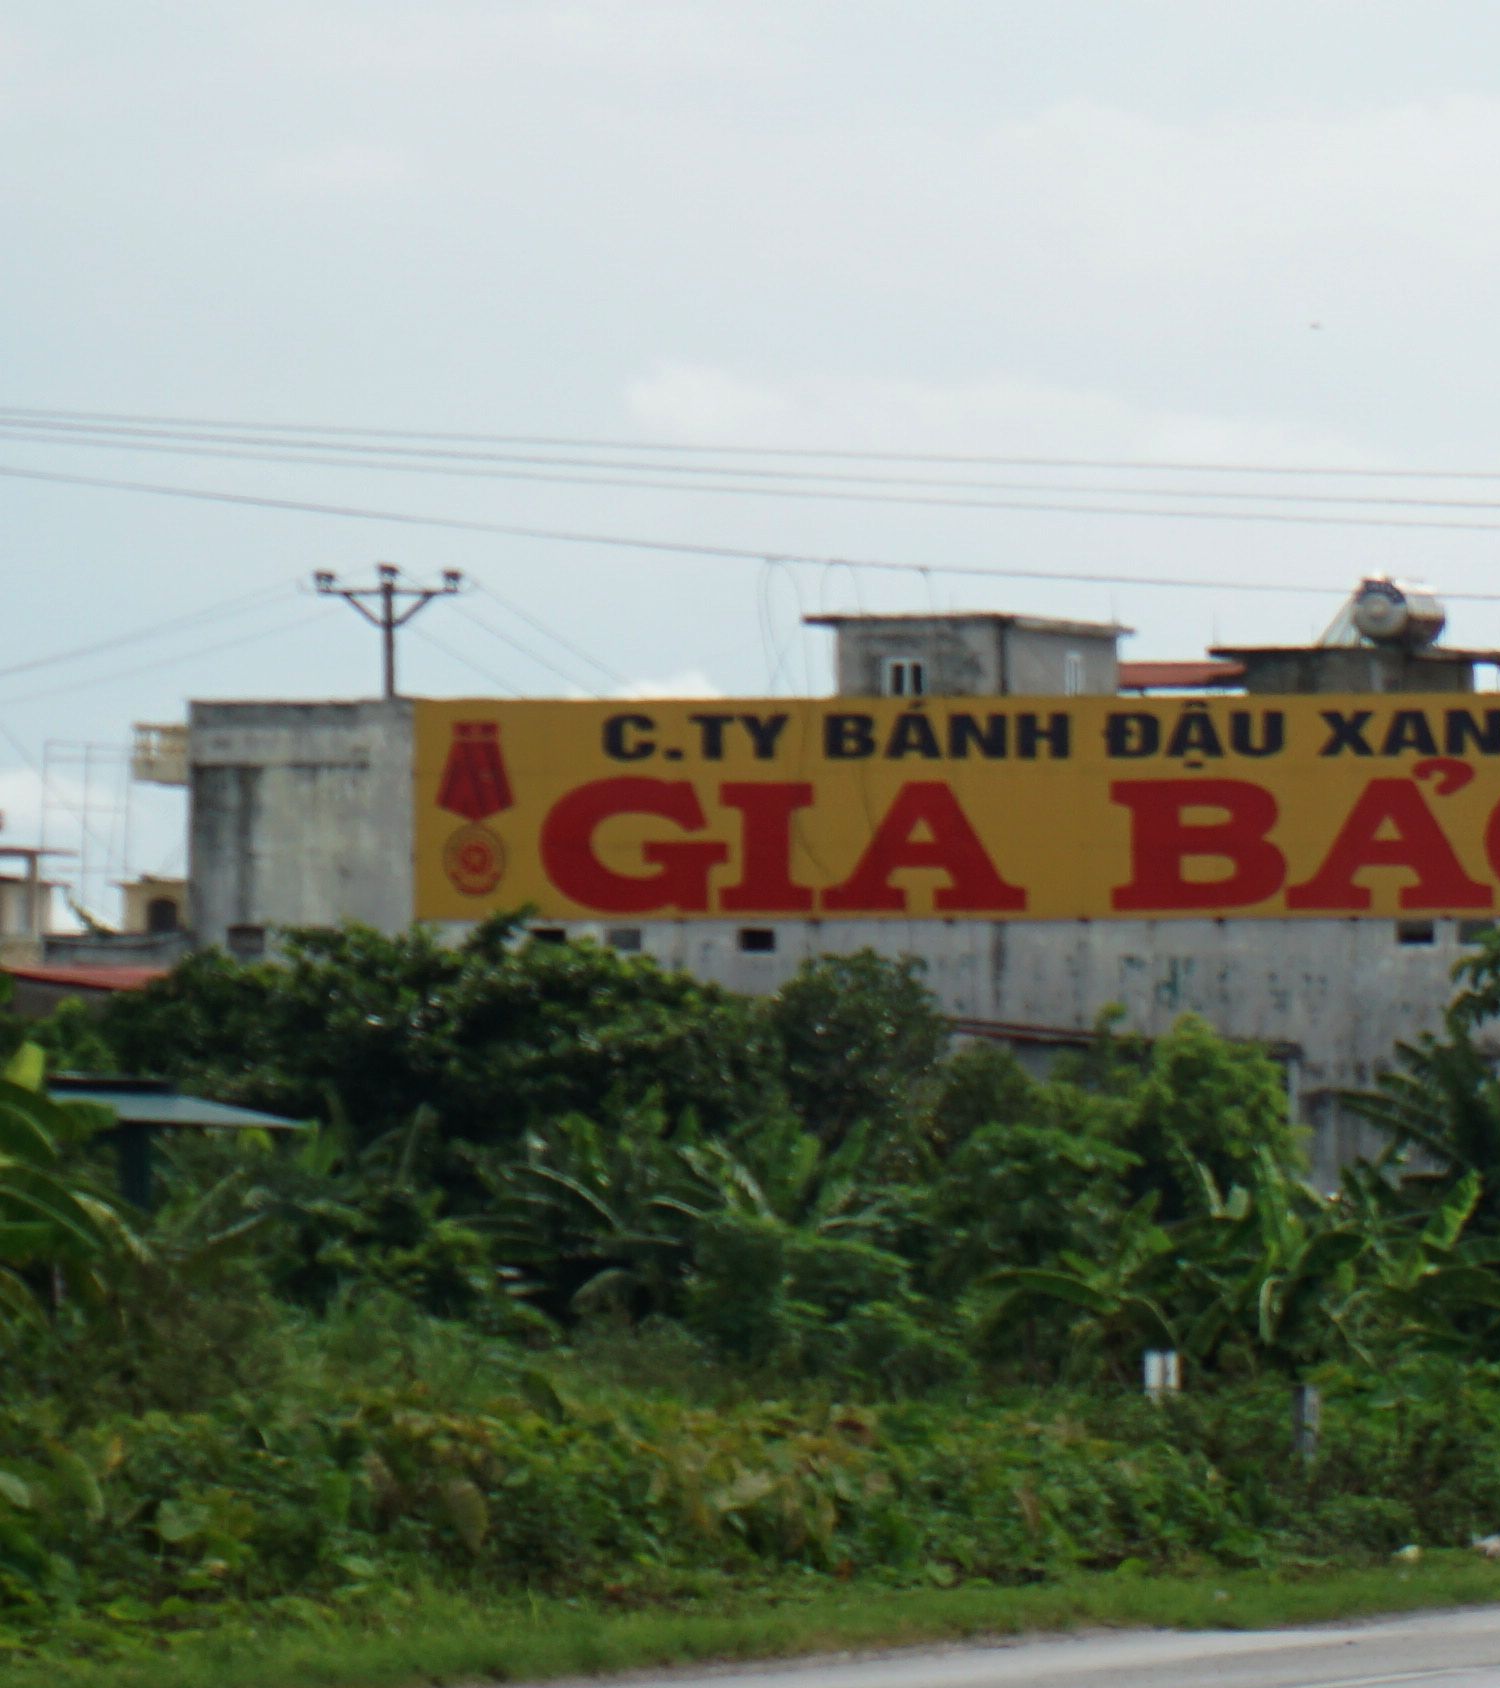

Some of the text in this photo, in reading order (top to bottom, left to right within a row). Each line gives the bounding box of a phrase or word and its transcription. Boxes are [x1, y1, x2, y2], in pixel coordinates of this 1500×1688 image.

[603, 712, 788, 760] C.TY
[824, 702, 1068, 760] BÁNH
[1103, 701, 1284, 768] ĐẬU
[540, 775, 1028, 912] GIA
